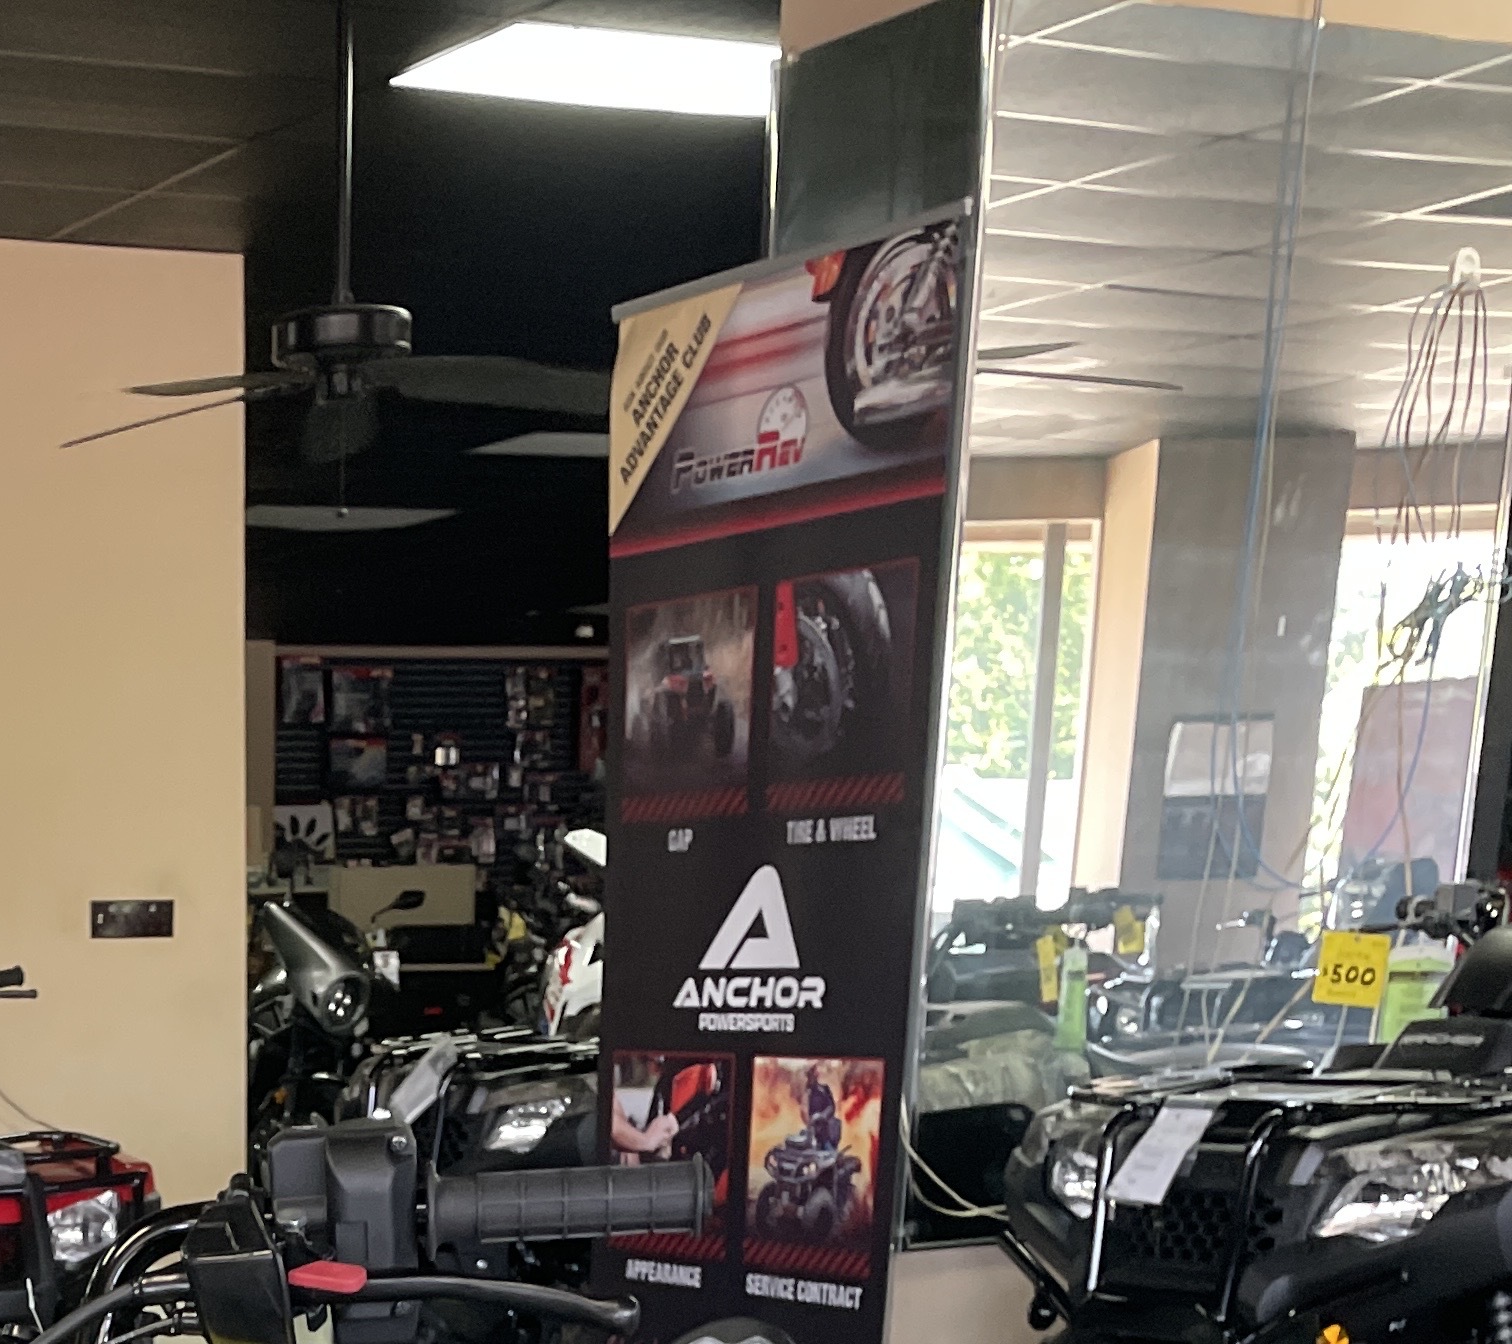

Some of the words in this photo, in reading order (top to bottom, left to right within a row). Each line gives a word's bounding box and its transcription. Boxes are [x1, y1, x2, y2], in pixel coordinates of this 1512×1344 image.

[620, 368, 684, 486] ADVANTAGE
[682, 312, 713, 370] CLUB
[632, 342, 680, 427] ANCHOR
[668, 828, 693, 852] GAP
[829, 814, 877, 841] WHEEL
[672, 976, 826, 1008] ANCHOR
[698, 1012, 795, 1032] POWERSPORTS
[625, 1258, 702, 1288] APPEARANCE
[745, 1272, 795, 1300] SERVICE
[797, 1279, 863, 1310] CONTRACT
